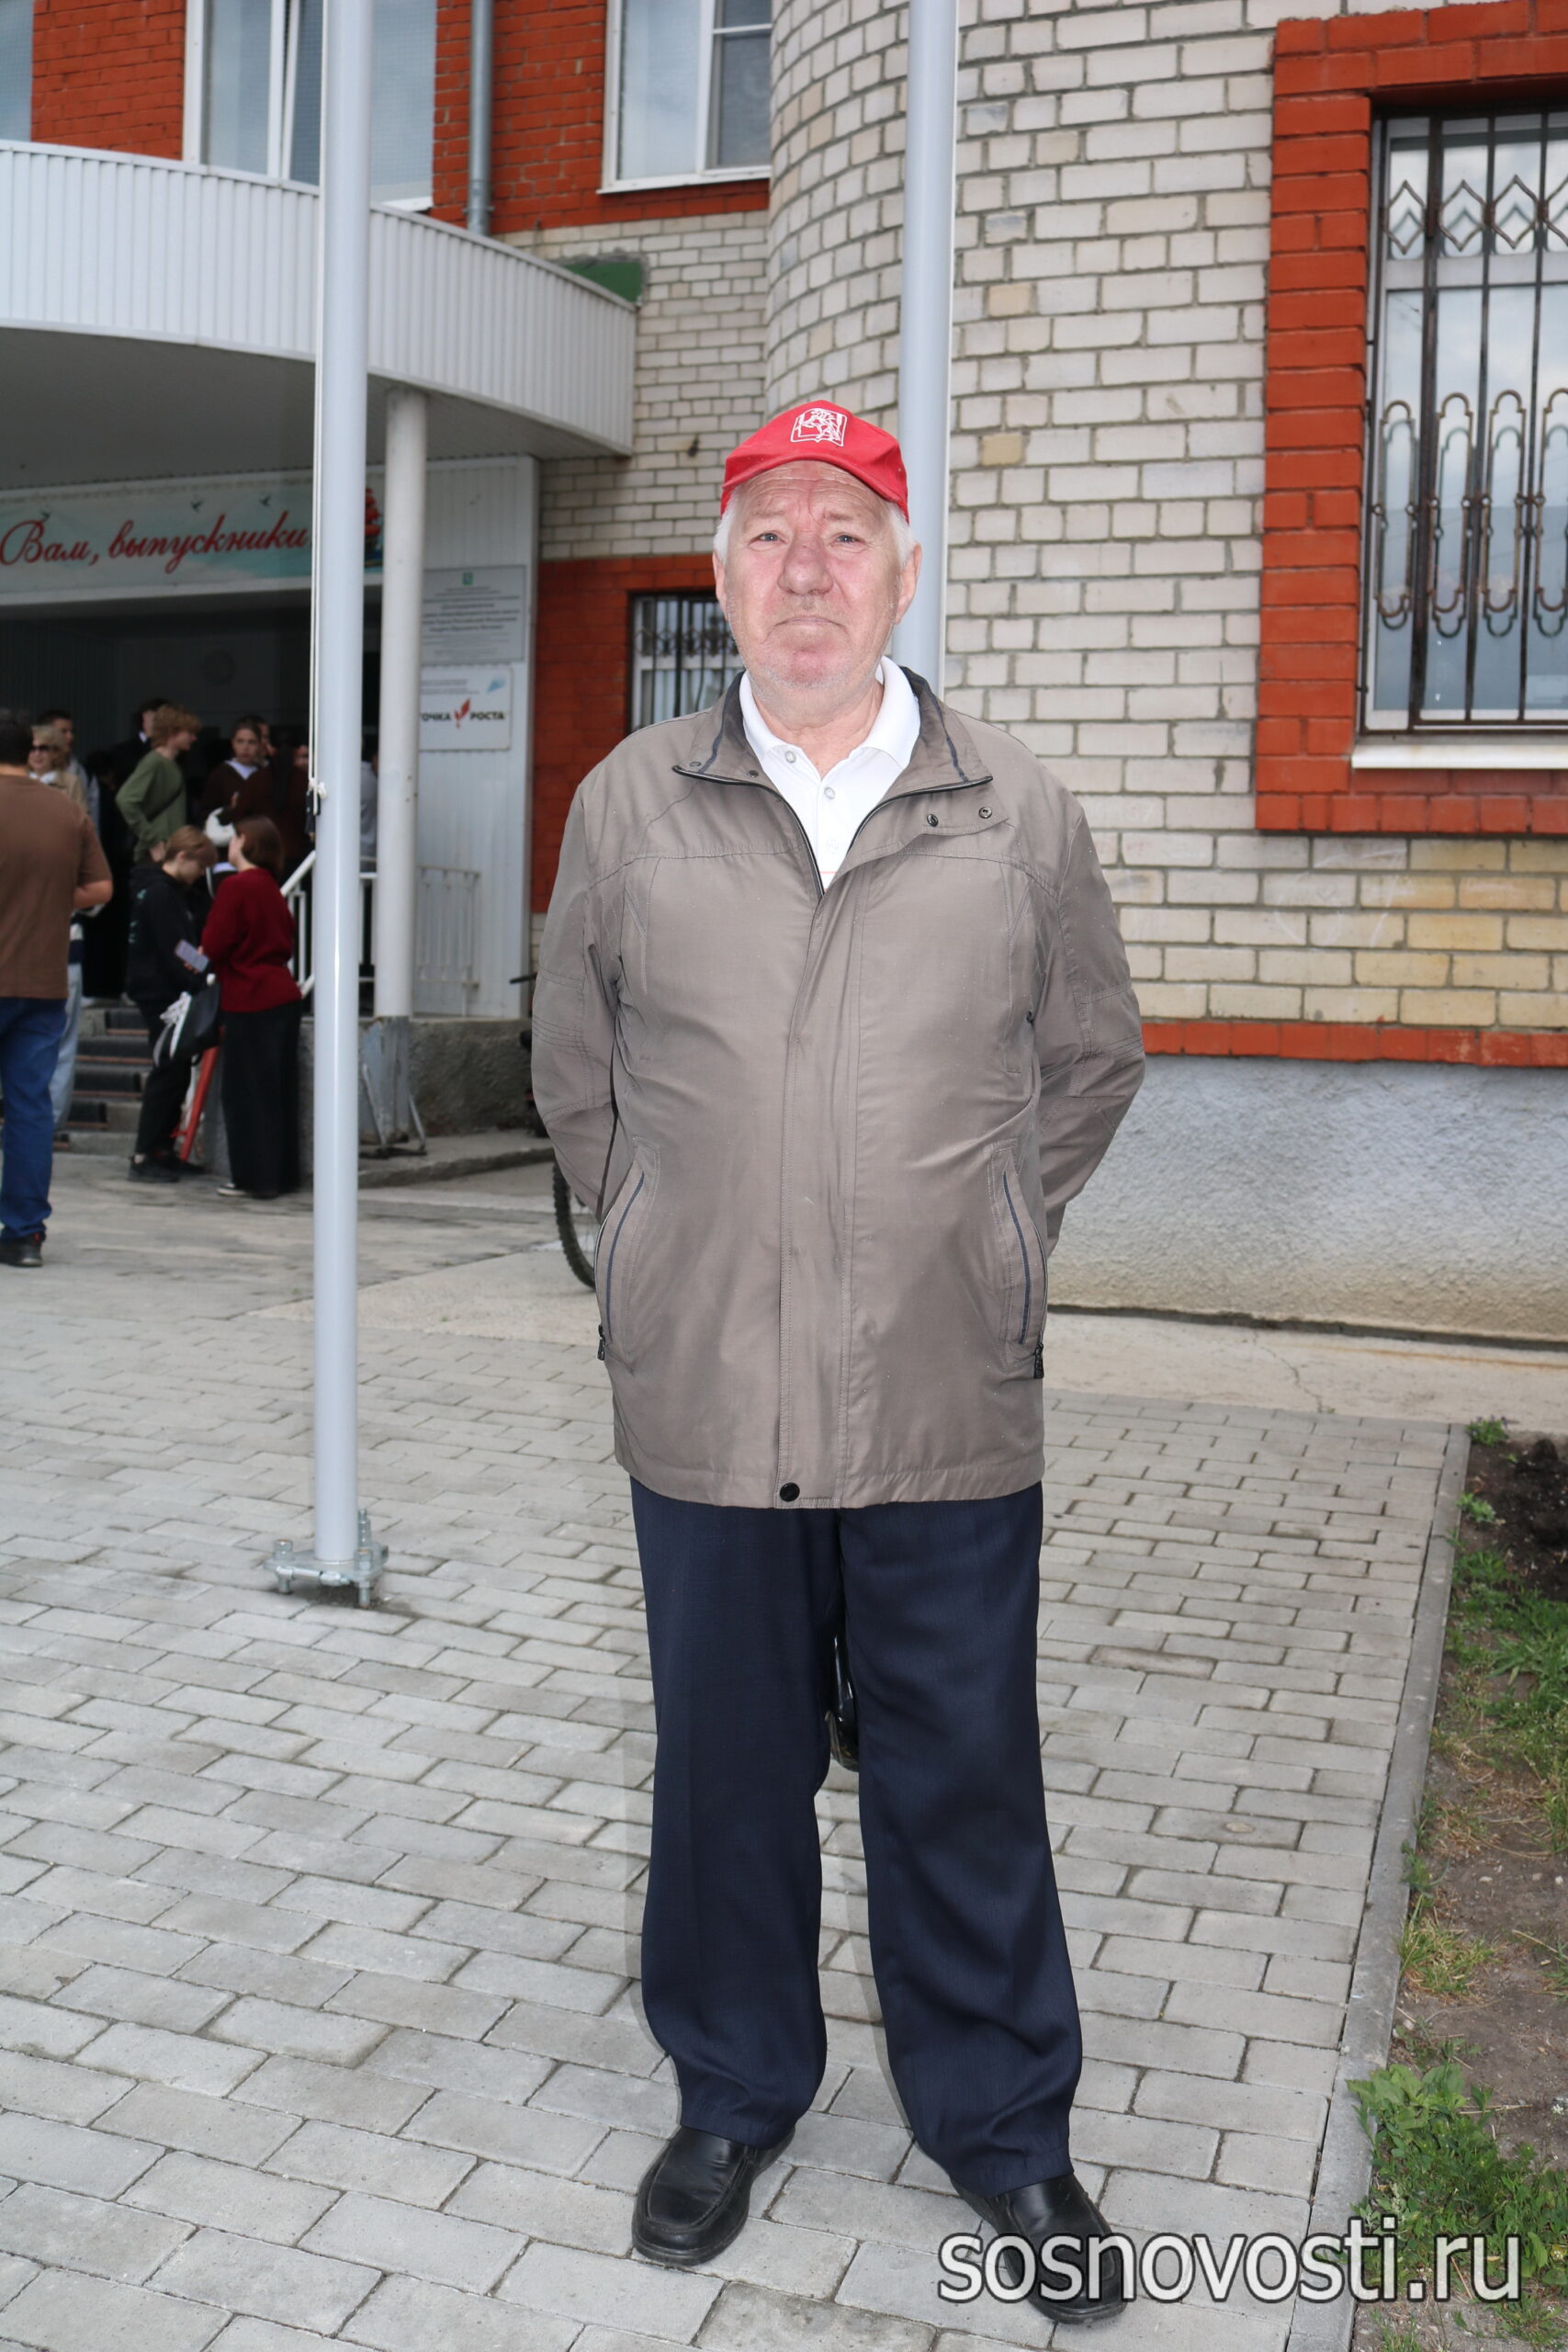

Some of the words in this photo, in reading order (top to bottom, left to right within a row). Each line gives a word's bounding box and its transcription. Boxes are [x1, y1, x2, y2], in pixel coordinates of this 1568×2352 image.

[0, 519, 99, 566] Вам,
[420, 711, 451, 722] ОЧКА
[469, 710, 504, 721] РОСТА
